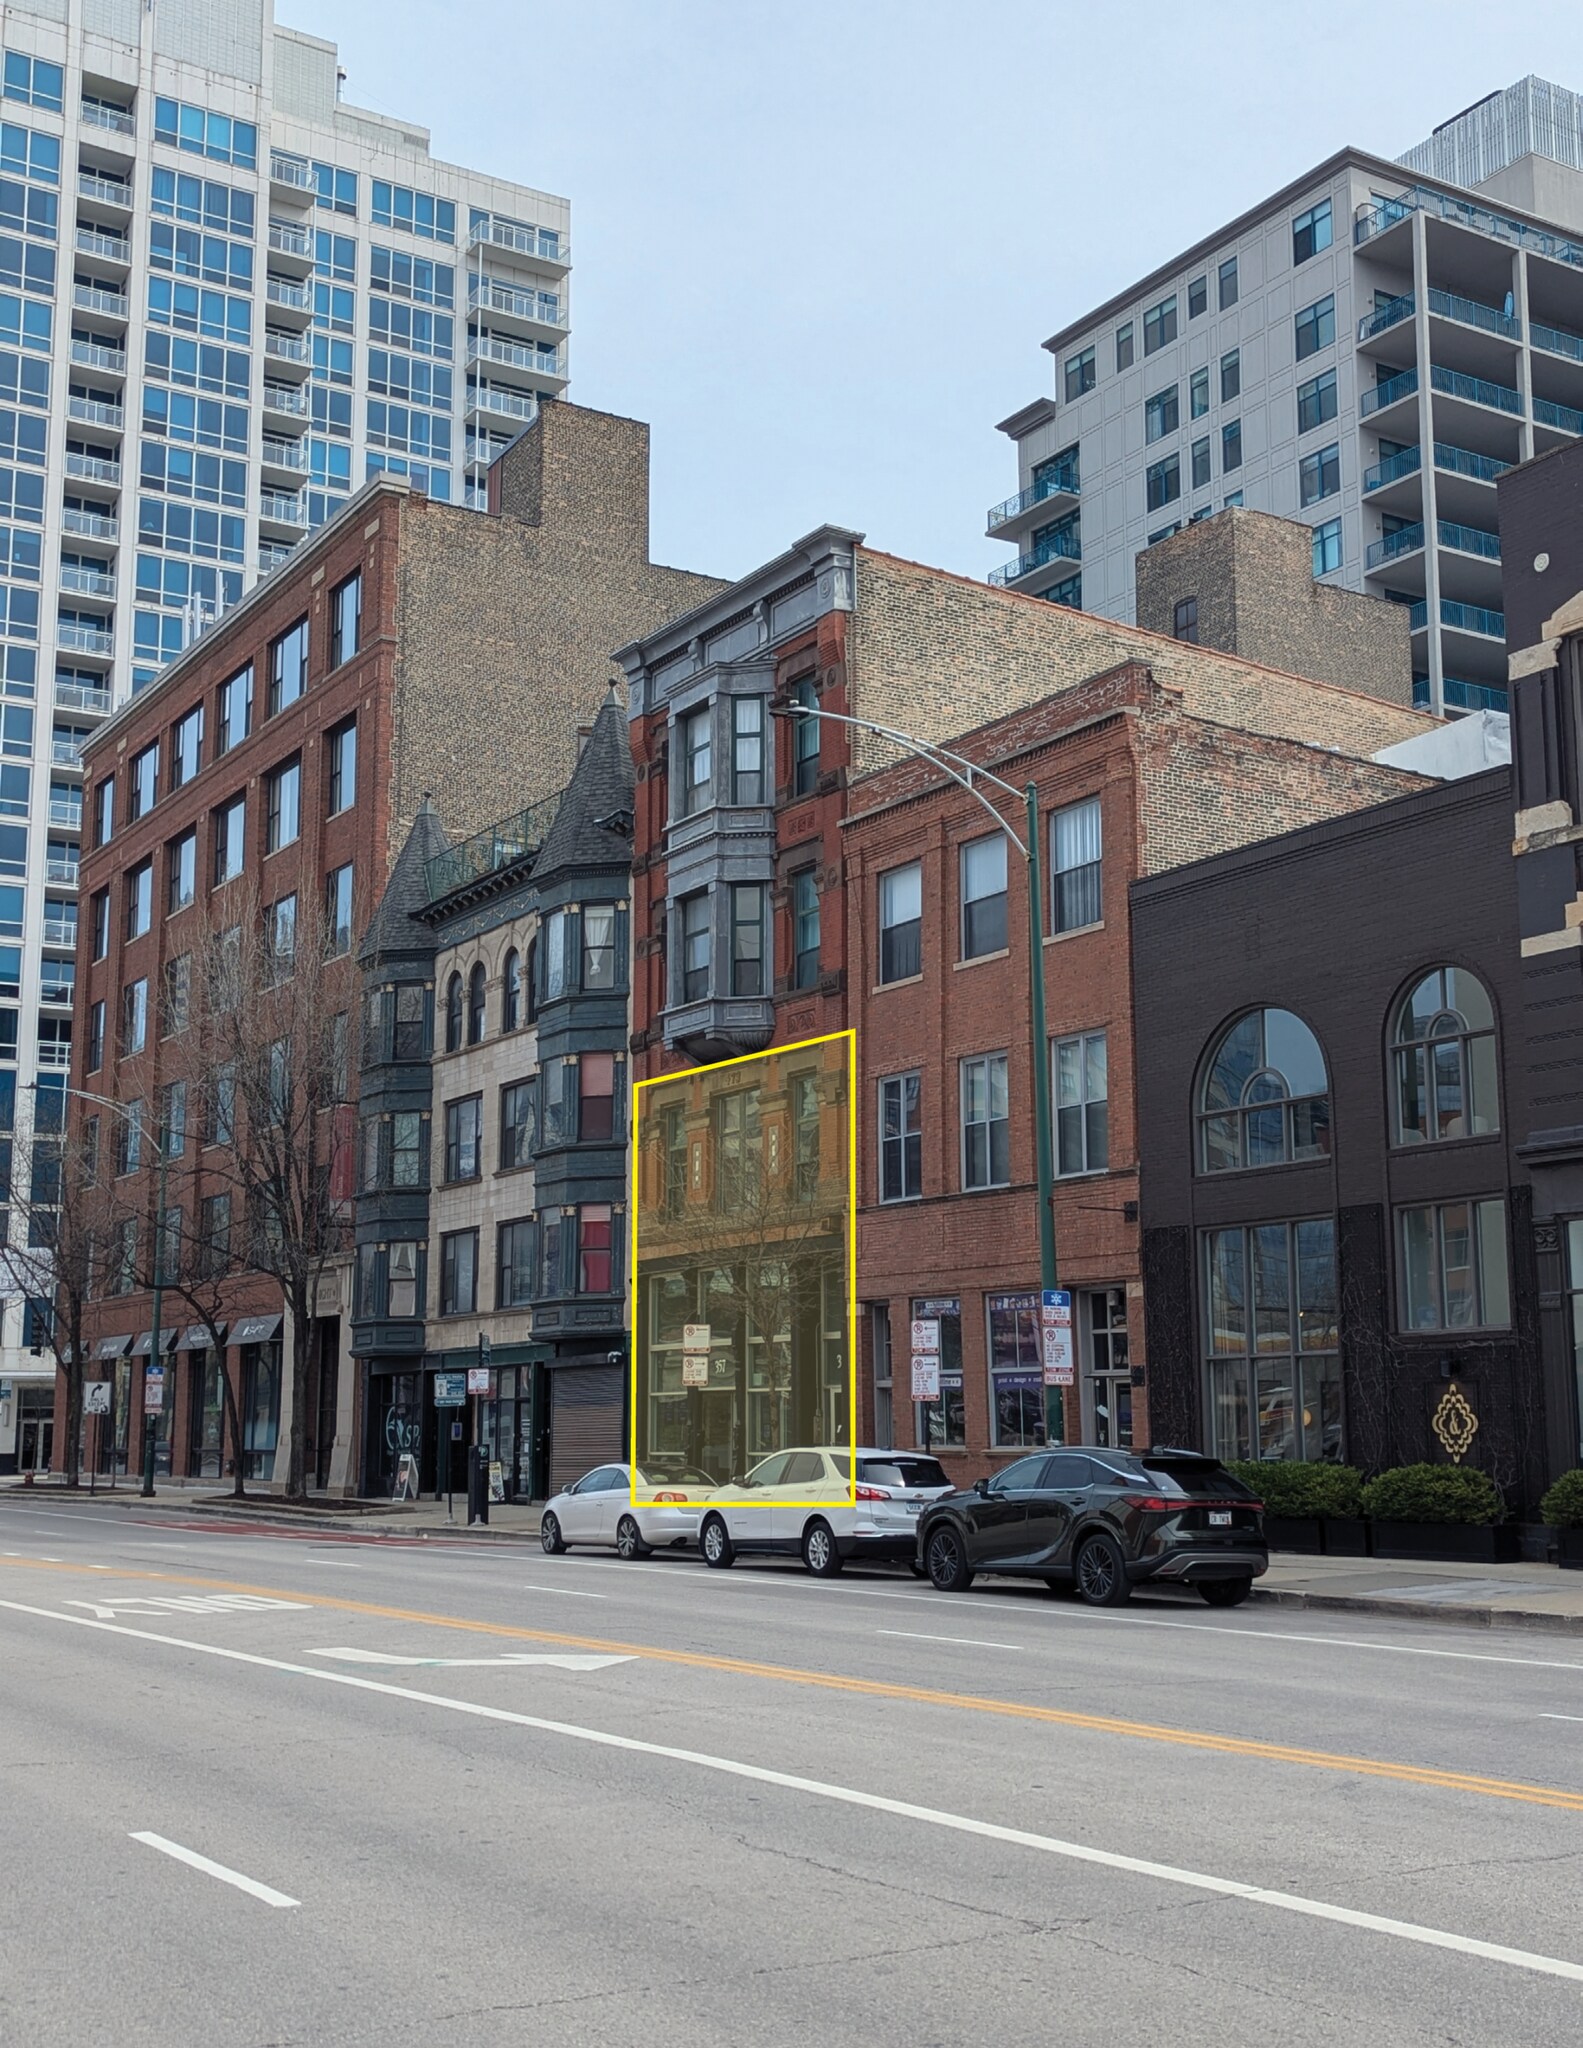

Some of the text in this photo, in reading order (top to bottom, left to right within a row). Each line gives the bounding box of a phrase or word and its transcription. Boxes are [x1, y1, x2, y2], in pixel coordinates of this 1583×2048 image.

[715, 1359, 726, 1374] 357
[1046, 1375, 1057, 1383] BUS
[61, 1593, 314, 1618] ONLY
